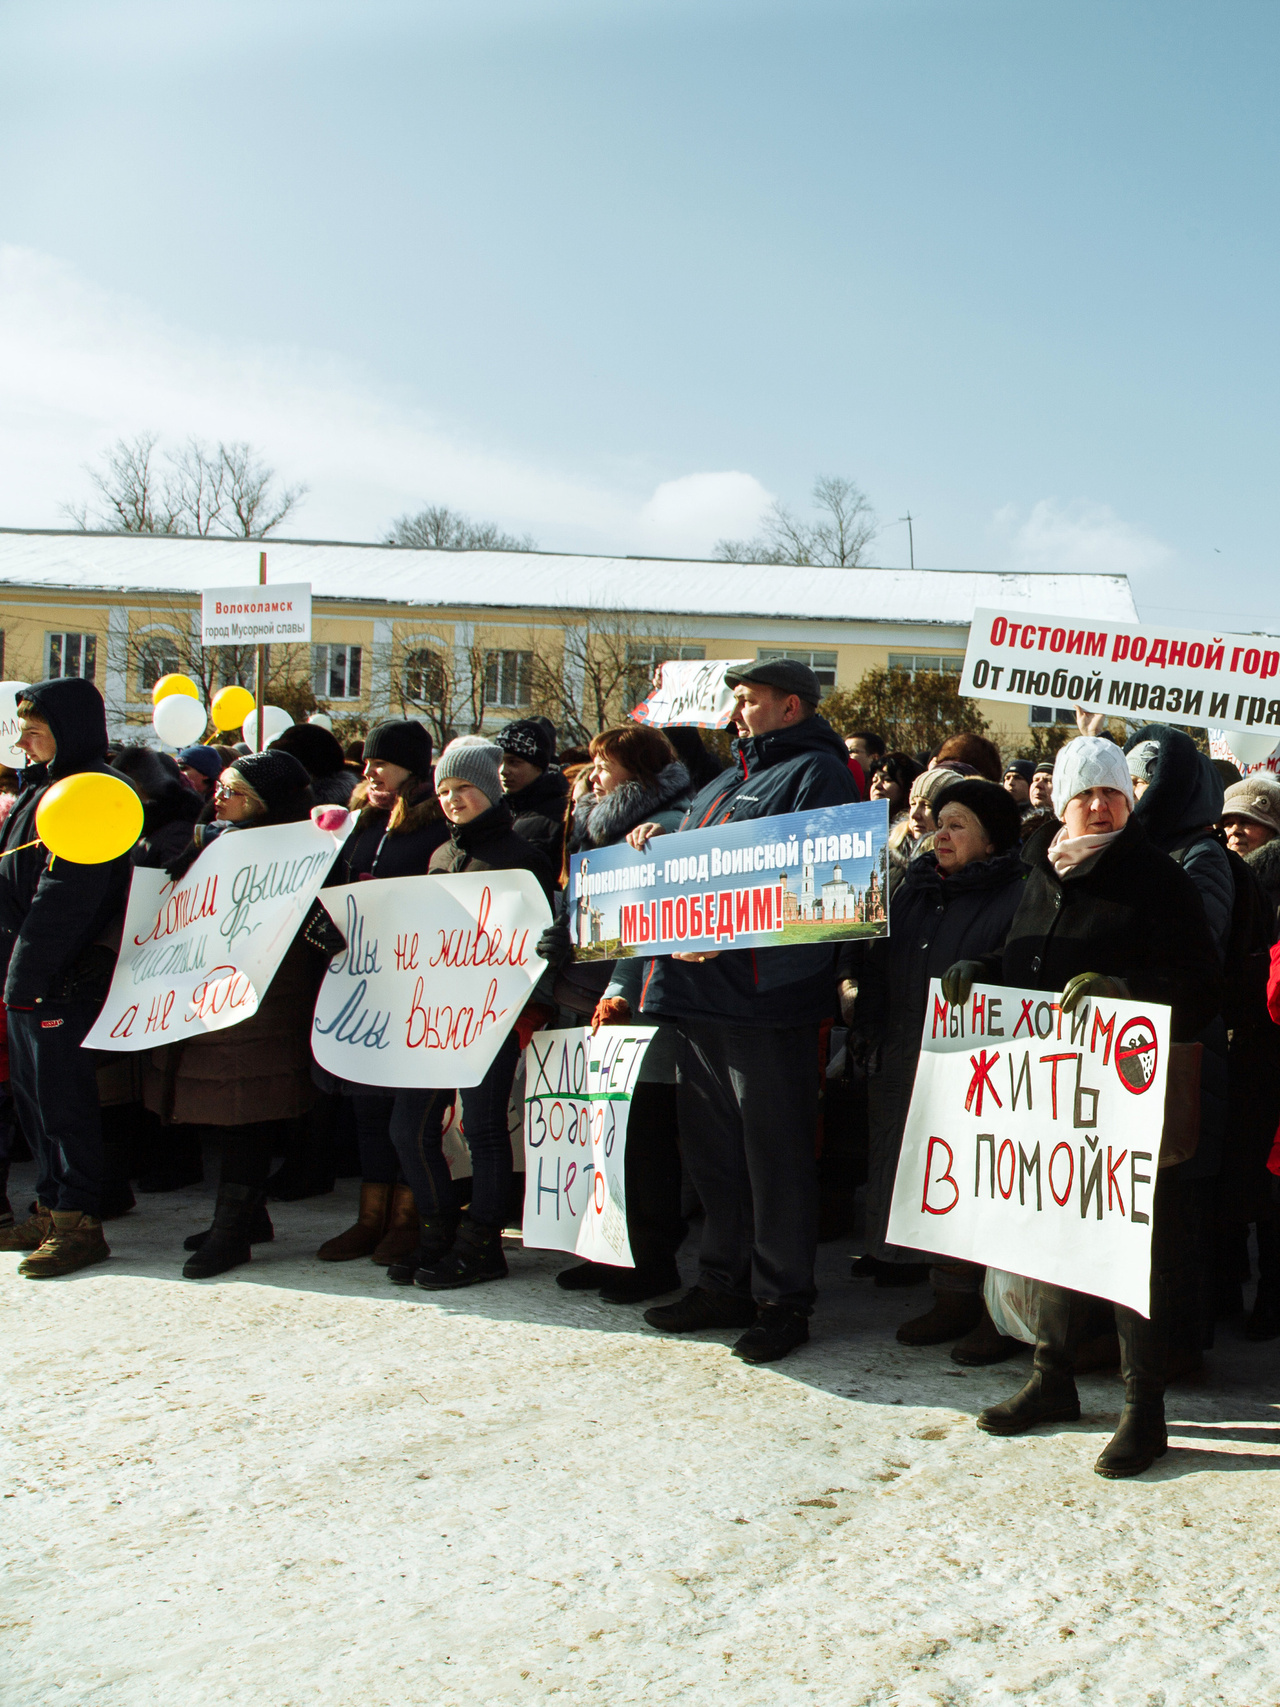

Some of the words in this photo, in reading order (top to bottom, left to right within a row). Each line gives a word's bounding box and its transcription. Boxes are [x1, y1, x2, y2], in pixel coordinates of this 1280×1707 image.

[205, 626, 230, 640] город
[231, 622, 275, 639] Мусорной
[276, 623, 306, 634] славы
[215, 601, 293, 614] Волоколамск
[989, 616, 1108, 657] Отстоим
[1111, 634, 1223, 671] родной
[972, 659, 1004, 689] От
[1006, 667, 1103, 704] любой
[1107, 680, 1204, 714] мрази
[1208, 691, 1230, 718] и
[575, 862, 656, 899] Волоколамск
[664, 853, 709, 885] город
[711, 834, 799, 877] Воинской
[802, 831, 872, 865] славы
[328, 893, 382, 976] Мы
[394, 932, 419, 971] не
[430, 886, 530, 968] живём
[622, 899, 657, 945] МЫ
[661, 885, 783, 943] ПОБЕДИМ!
[144, 990, 176, 1034] не
[315, 979, 391, 1050] Мы
[932, 992, 965, 1039] МЫ
[972, 992, 1005, 1036] НЕ
[1012, 998, 1117, 1066] ХОТИМ
[964, 1050, 1100, 1128] ЖИТЬ
[921, 1136, 960, 1215] В
[974, 1134, 1152, 1226] ПОМОЙКЕ
